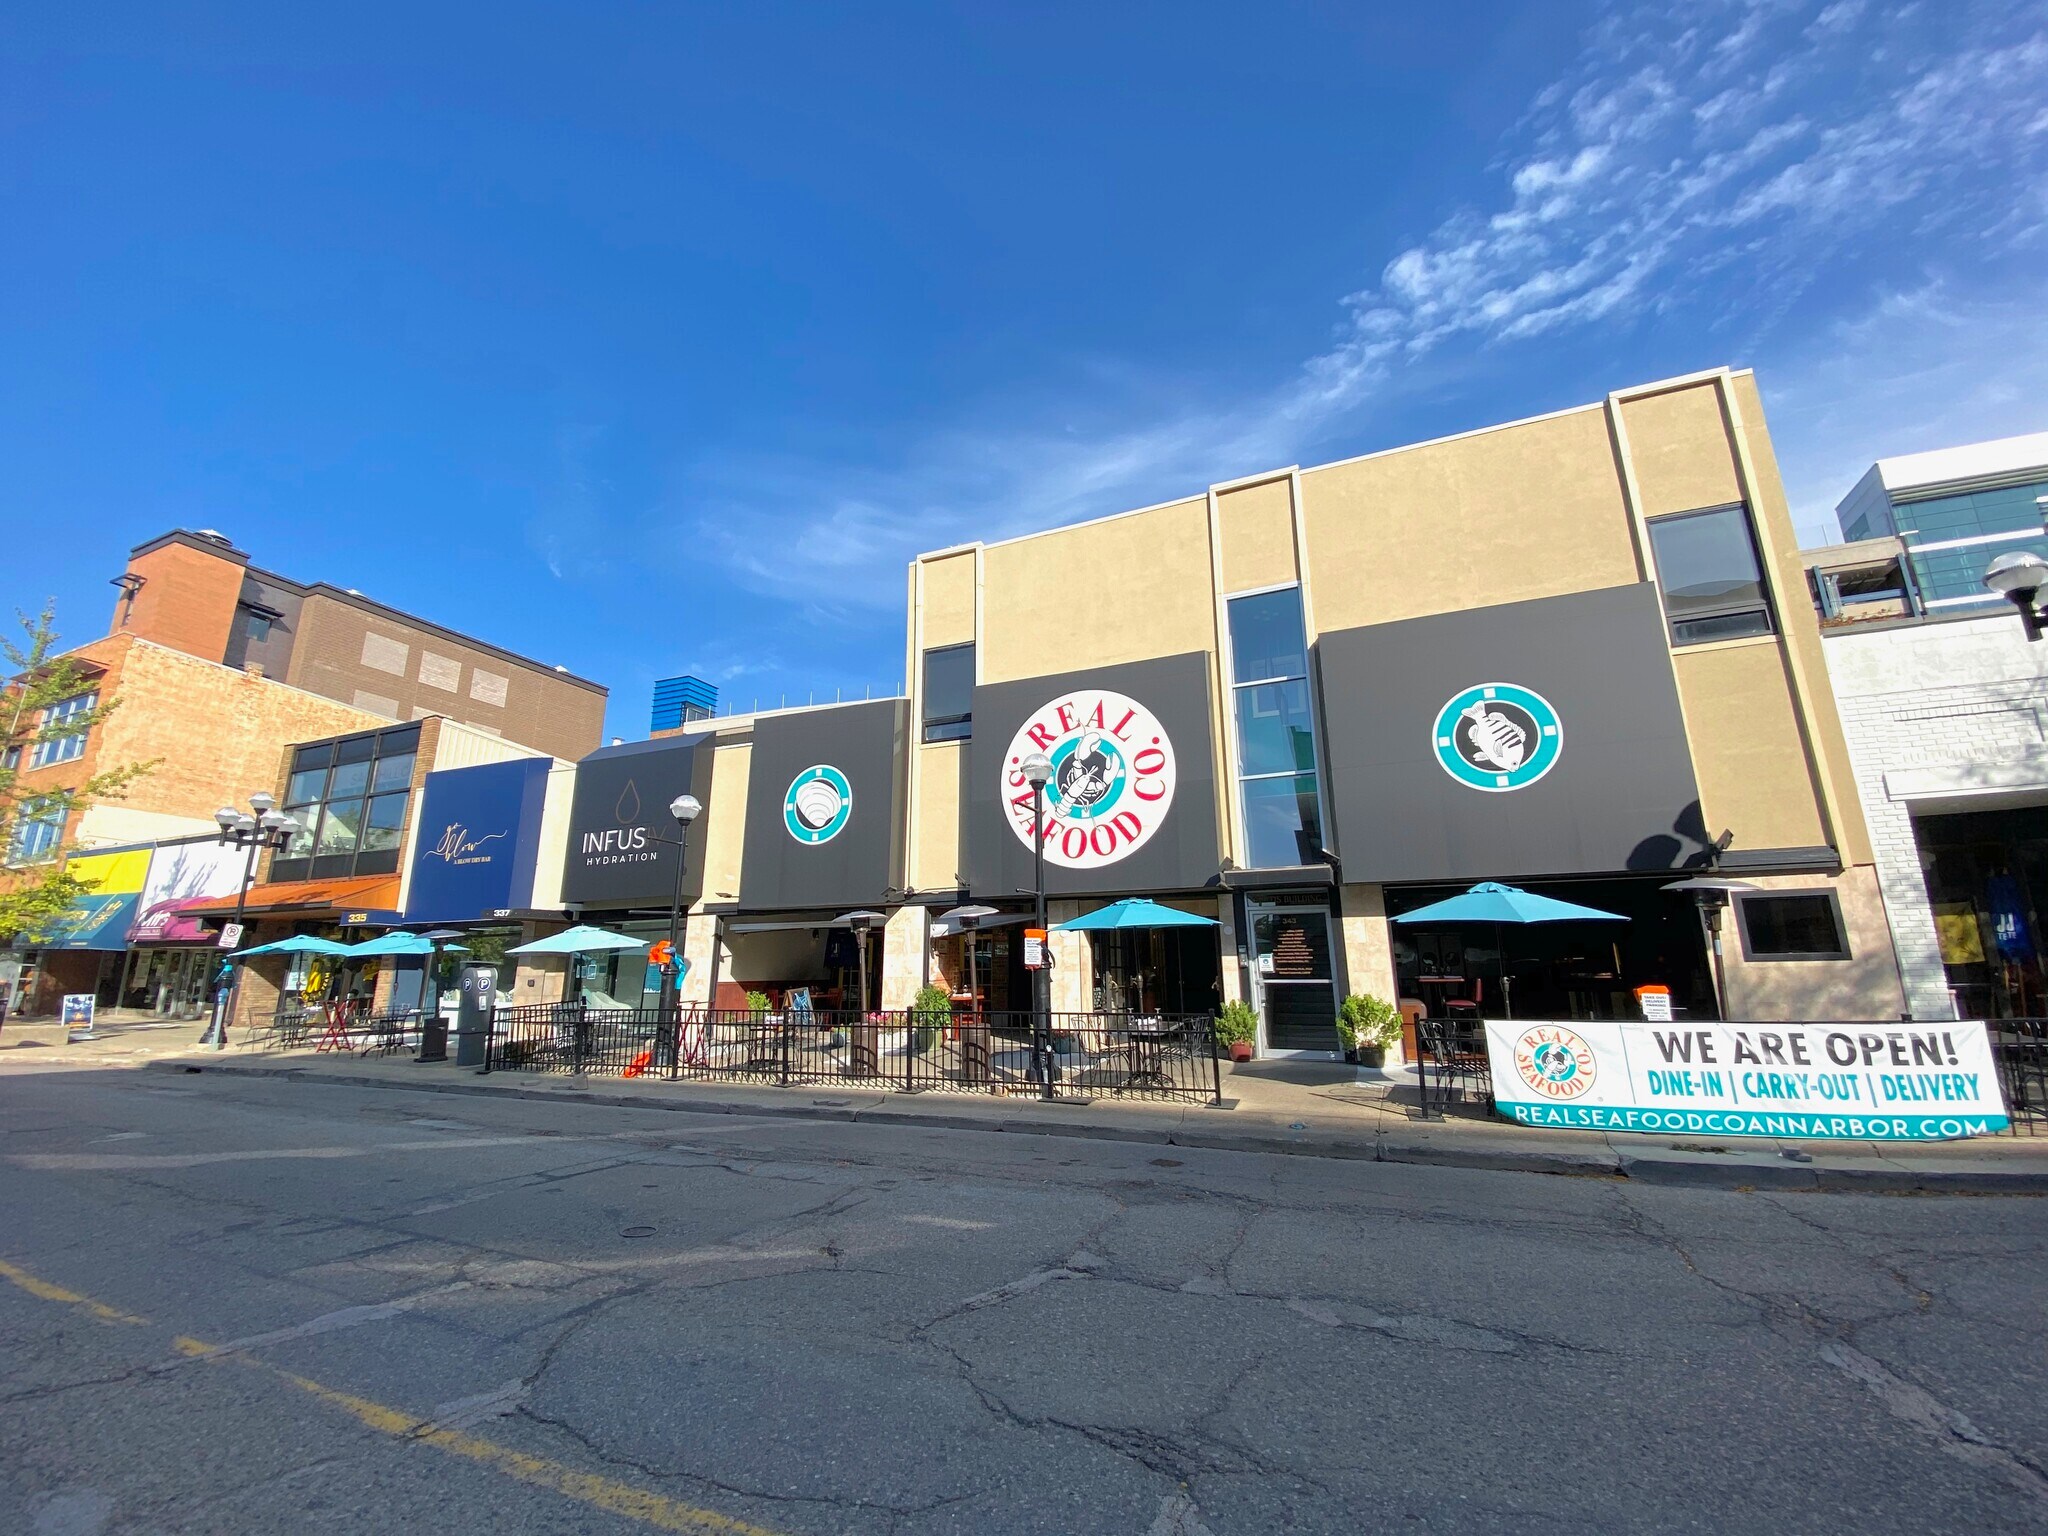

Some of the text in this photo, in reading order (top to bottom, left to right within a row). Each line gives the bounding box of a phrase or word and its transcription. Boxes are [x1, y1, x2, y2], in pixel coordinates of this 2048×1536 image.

[1025, 699, 1138, 752] REAL
[586, 852, 657, 866] HYDRATION
[1283, 894, 1322, 903] BUILDING
[348, 913, 367, 922] 335
[493, 909, 511, 917] 337
[1524, 1028, 1575, 1049] REAL
[1652, 1031, 1959, 1066] WE ARE OPEN!
[1518, 1054, 1584, 1096] SEAFOOD
[1648, 1070, 1980, 1102] DINE-IN CARRY-OUT DELIVERY
[1515, 1105, 1988, 1138] REALSEAFOODCOANNARBOR.COM
